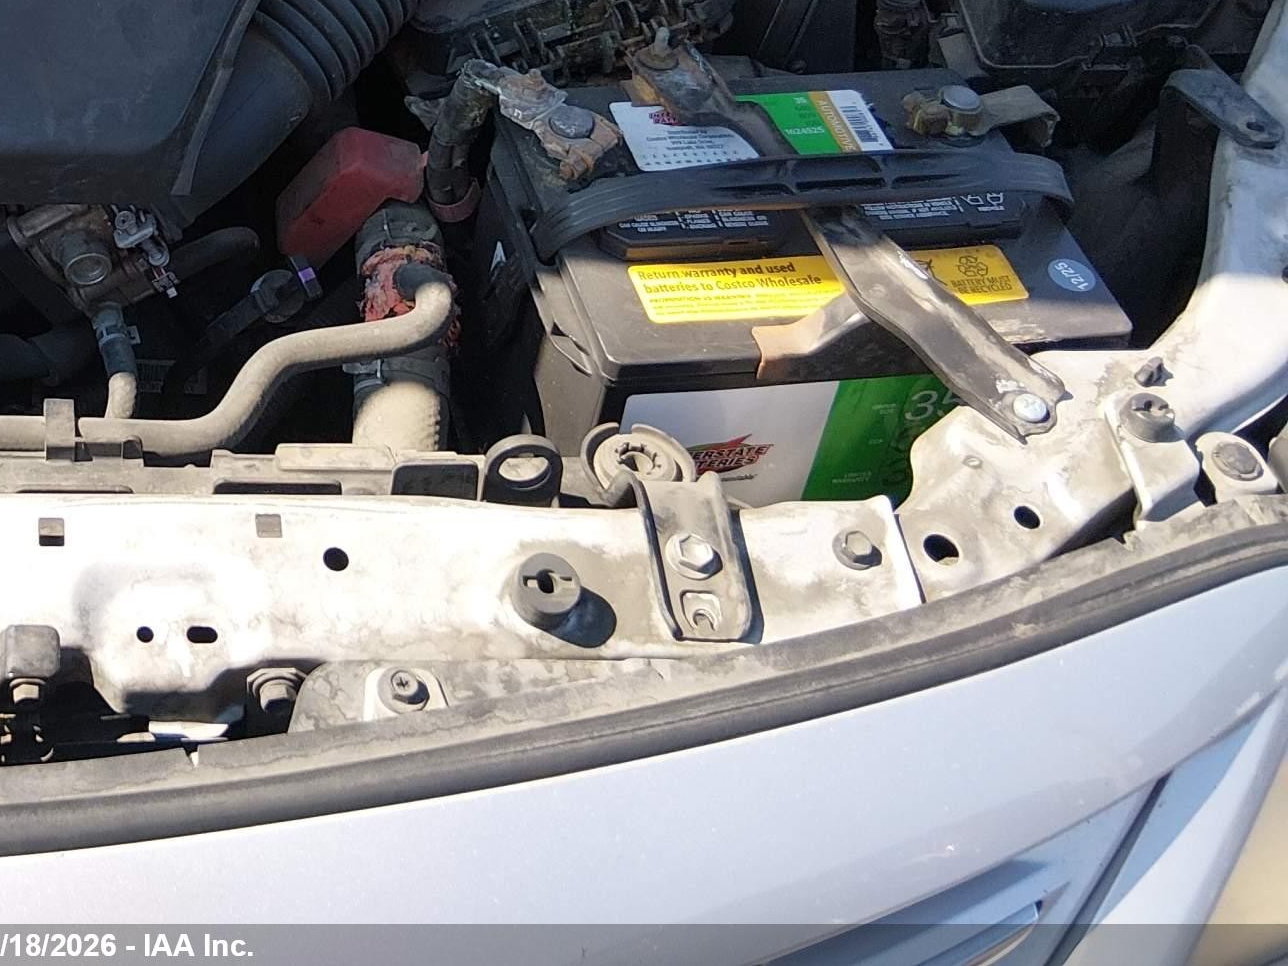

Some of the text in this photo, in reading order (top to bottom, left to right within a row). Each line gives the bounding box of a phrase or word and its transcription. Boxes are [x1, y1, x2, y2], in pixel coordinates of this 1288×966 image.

[817, 100, 857, 151] AUTOMOTIVE
[637, 261, 796, 281] Return warranty and used
[1054, 261, 1090, 291] 12/25
[643, 274, 823, 294] batteries to Costco Wholesale
[950, 274, 1011, 289] BATTERY MUST
[957, 283, 1013, 295] BE RECYCLED
